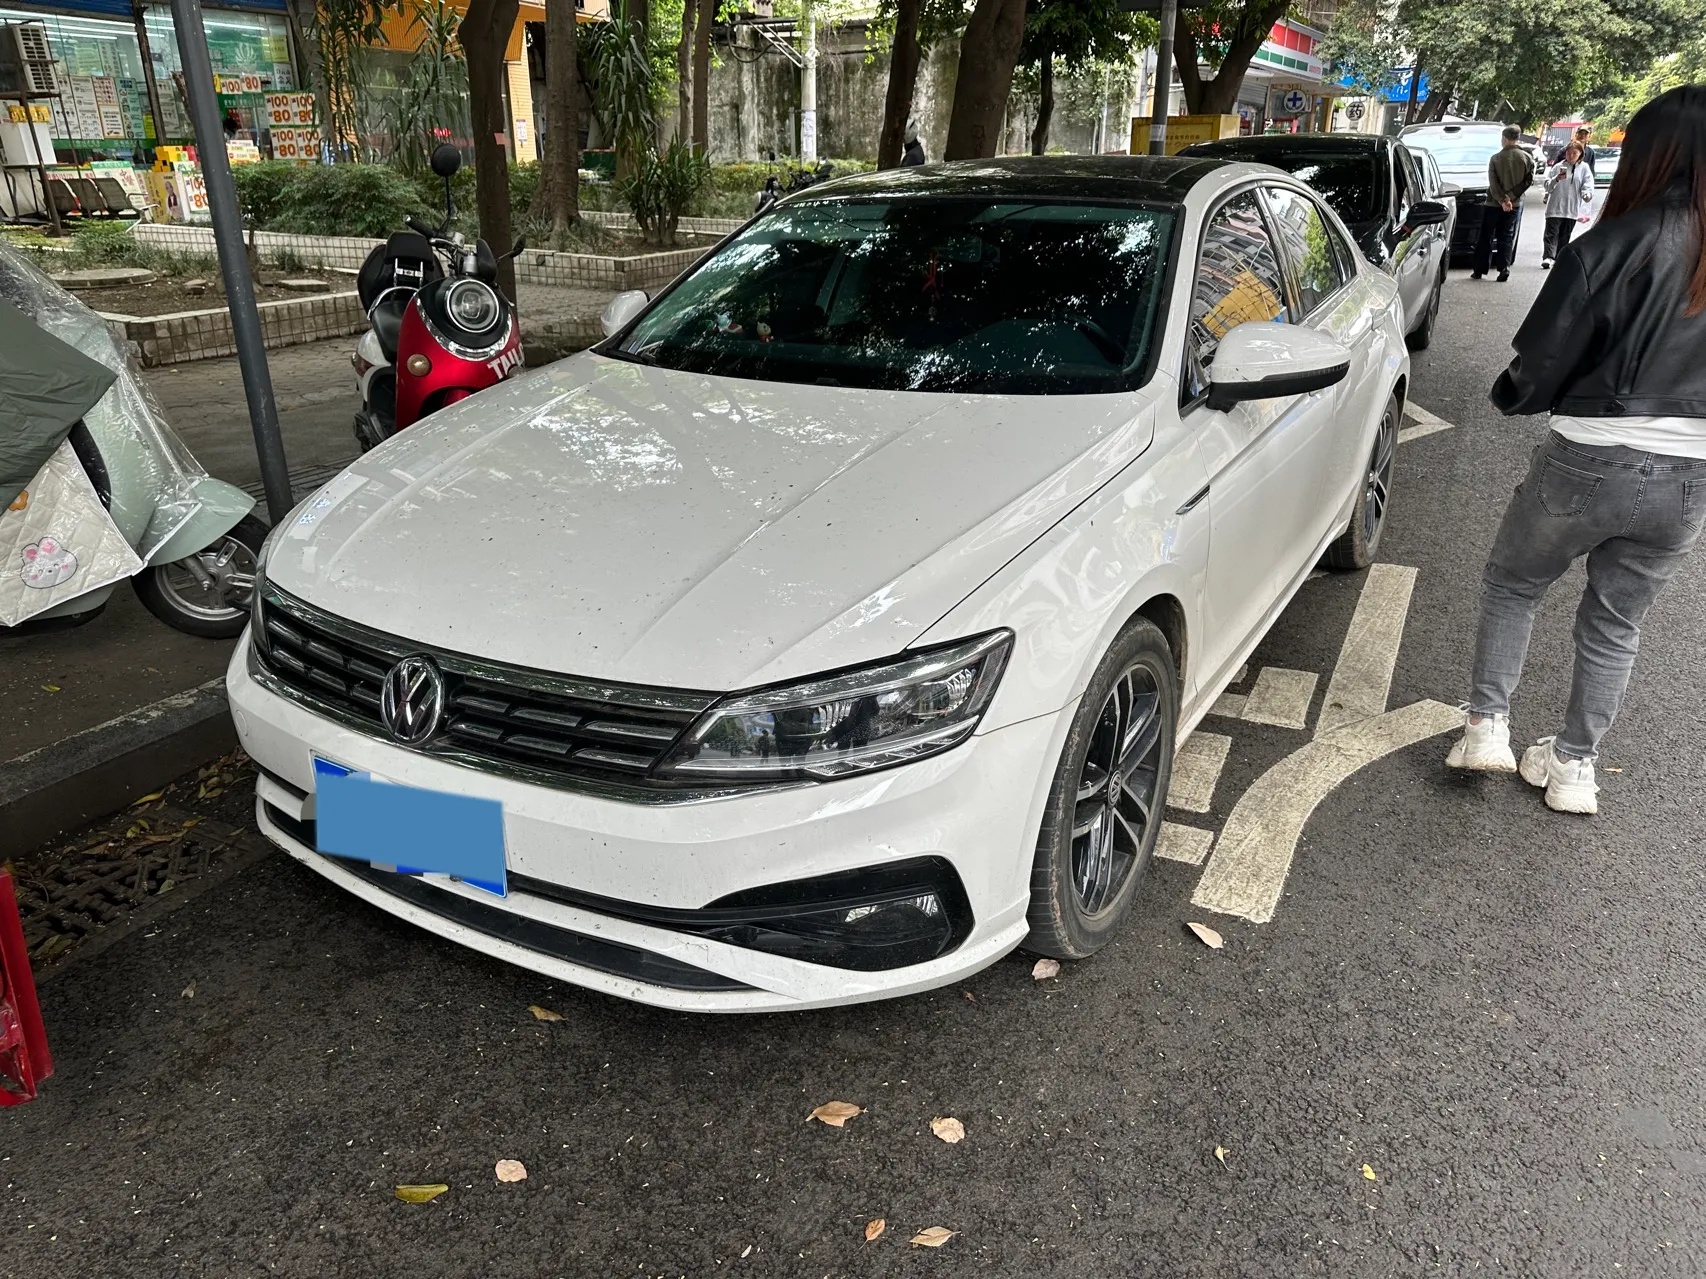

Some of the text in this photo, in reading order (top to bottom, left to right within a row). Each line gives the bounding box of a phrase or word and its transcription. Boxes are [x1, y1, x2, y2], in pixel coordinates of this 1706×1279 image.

[273, 109, 290, 123] 80
[1348, 104, 1363, 118] 药
[279, 143, 296, 157] 80
